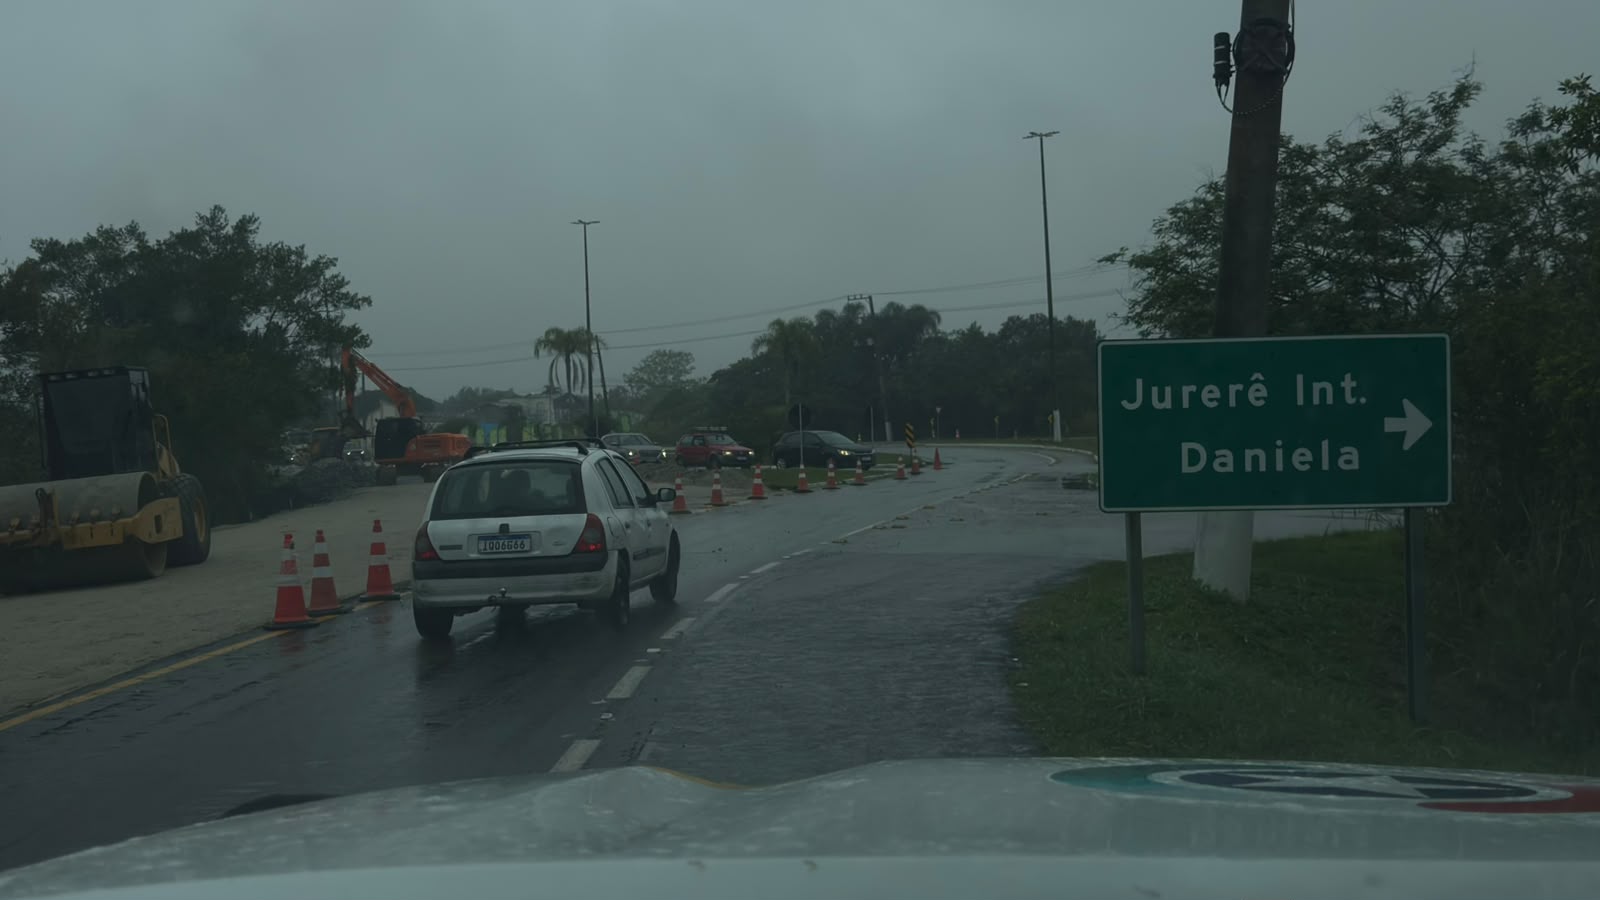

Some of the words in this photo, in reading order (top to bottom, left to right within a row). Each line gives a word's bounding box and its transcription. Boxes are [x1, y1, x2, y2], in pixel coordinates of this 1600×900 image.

[1121, 373, 1268, 410] Jurerê
[1296, 372, 1368, 406] Int.
[1181, 439, 1361, 474] Daniela
